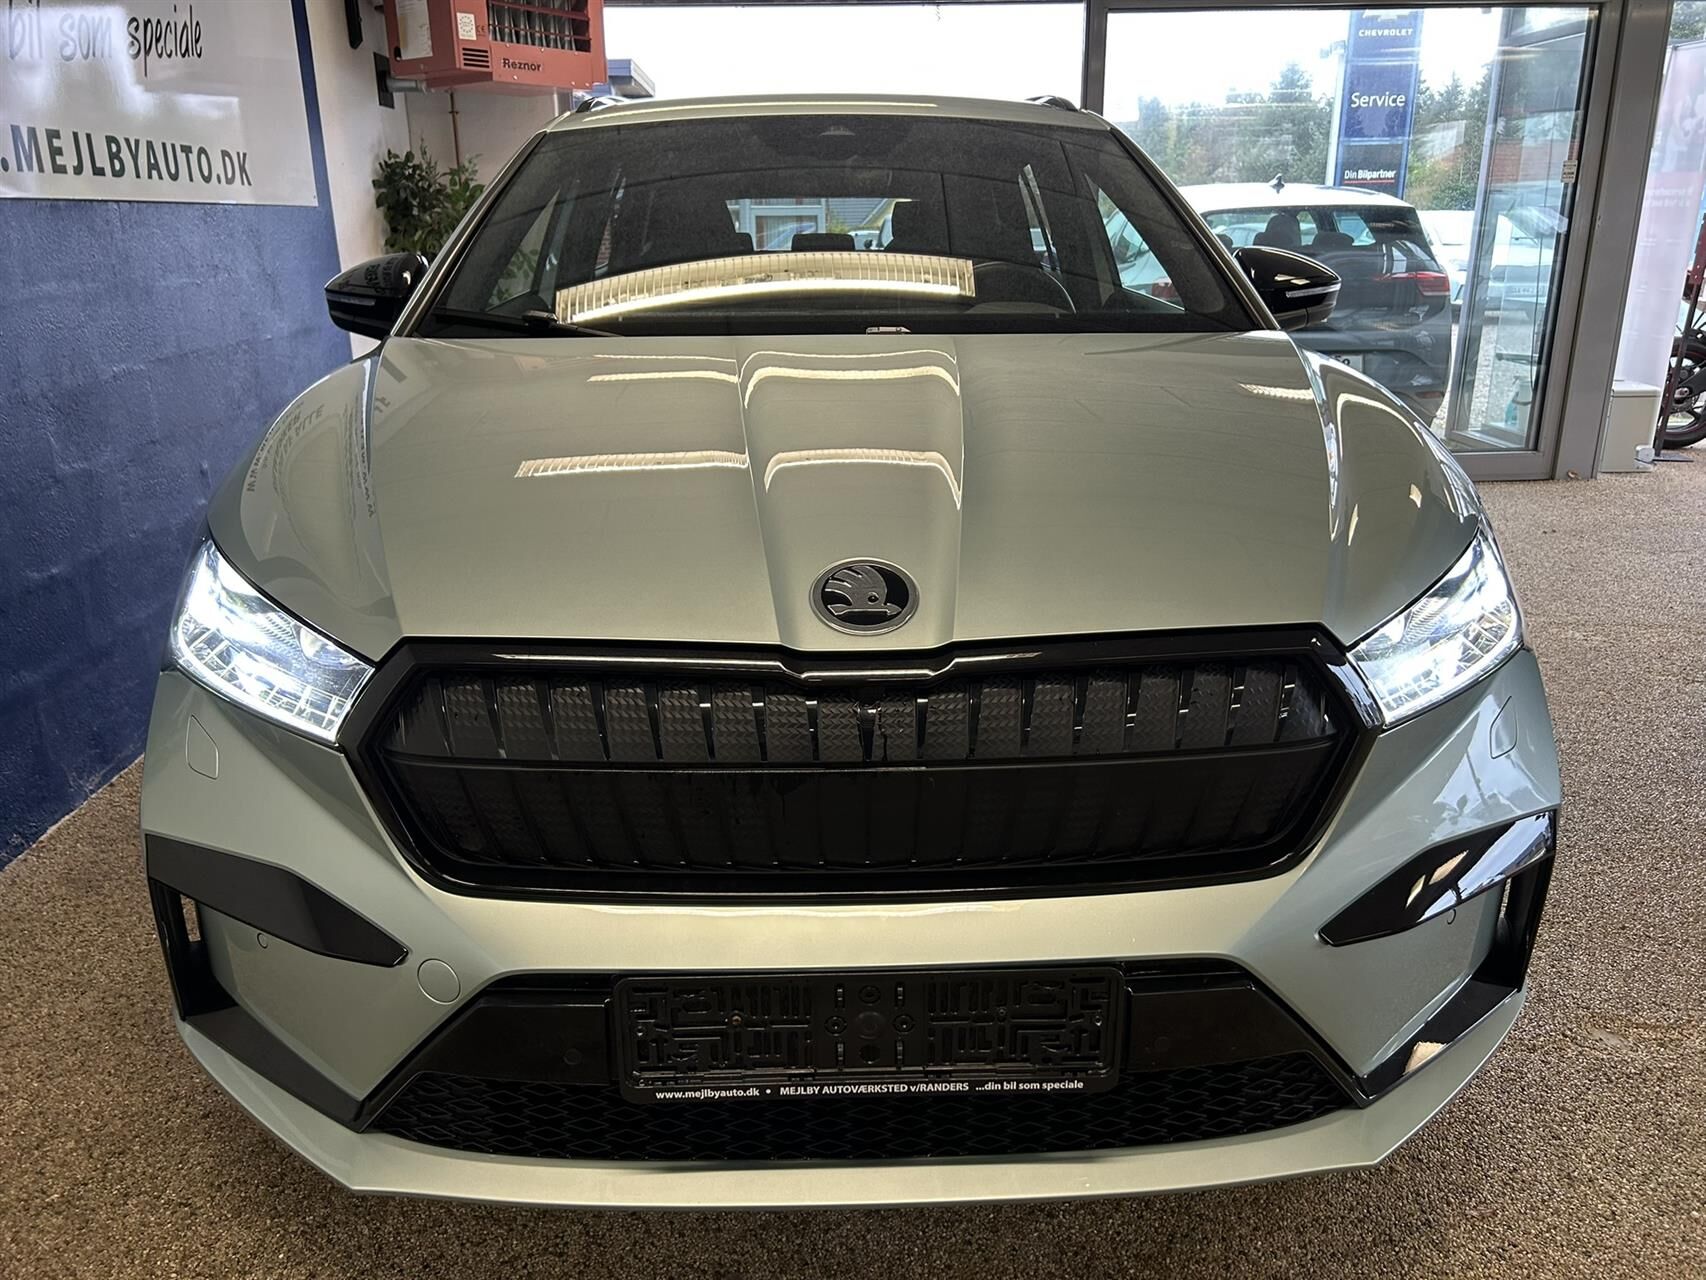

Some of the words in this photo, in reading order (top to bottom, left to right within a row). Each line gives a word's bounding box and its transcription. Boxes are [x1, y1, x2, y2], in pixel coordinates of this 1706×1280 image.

[1358, 28, 1413, 37] CHEVROLET
[59, 13, 113, 62] som
[127, 4, 202, 77] speciale
[502, 58, 542, 72] Reznor
[1351, 91, 1406, 108] Service
[1344, 169, 1357, 179] Din
[1357, 169, 1396, 181] Bilpartner
[655, 1087, 760, 1100] www.mejlbyauto.dk
[780, 1086, 819, 1096] MEJLBY
[822, 1084, 908, 1095] AUTOVÆRKSTED
[910, 1082, 969, 1093] v/RANDERS
[1003, 1081, 1017, 1091] bil
[1018, 1082, 1040, 1091] som
[1041, 1080, 1084, 1092] speciale
